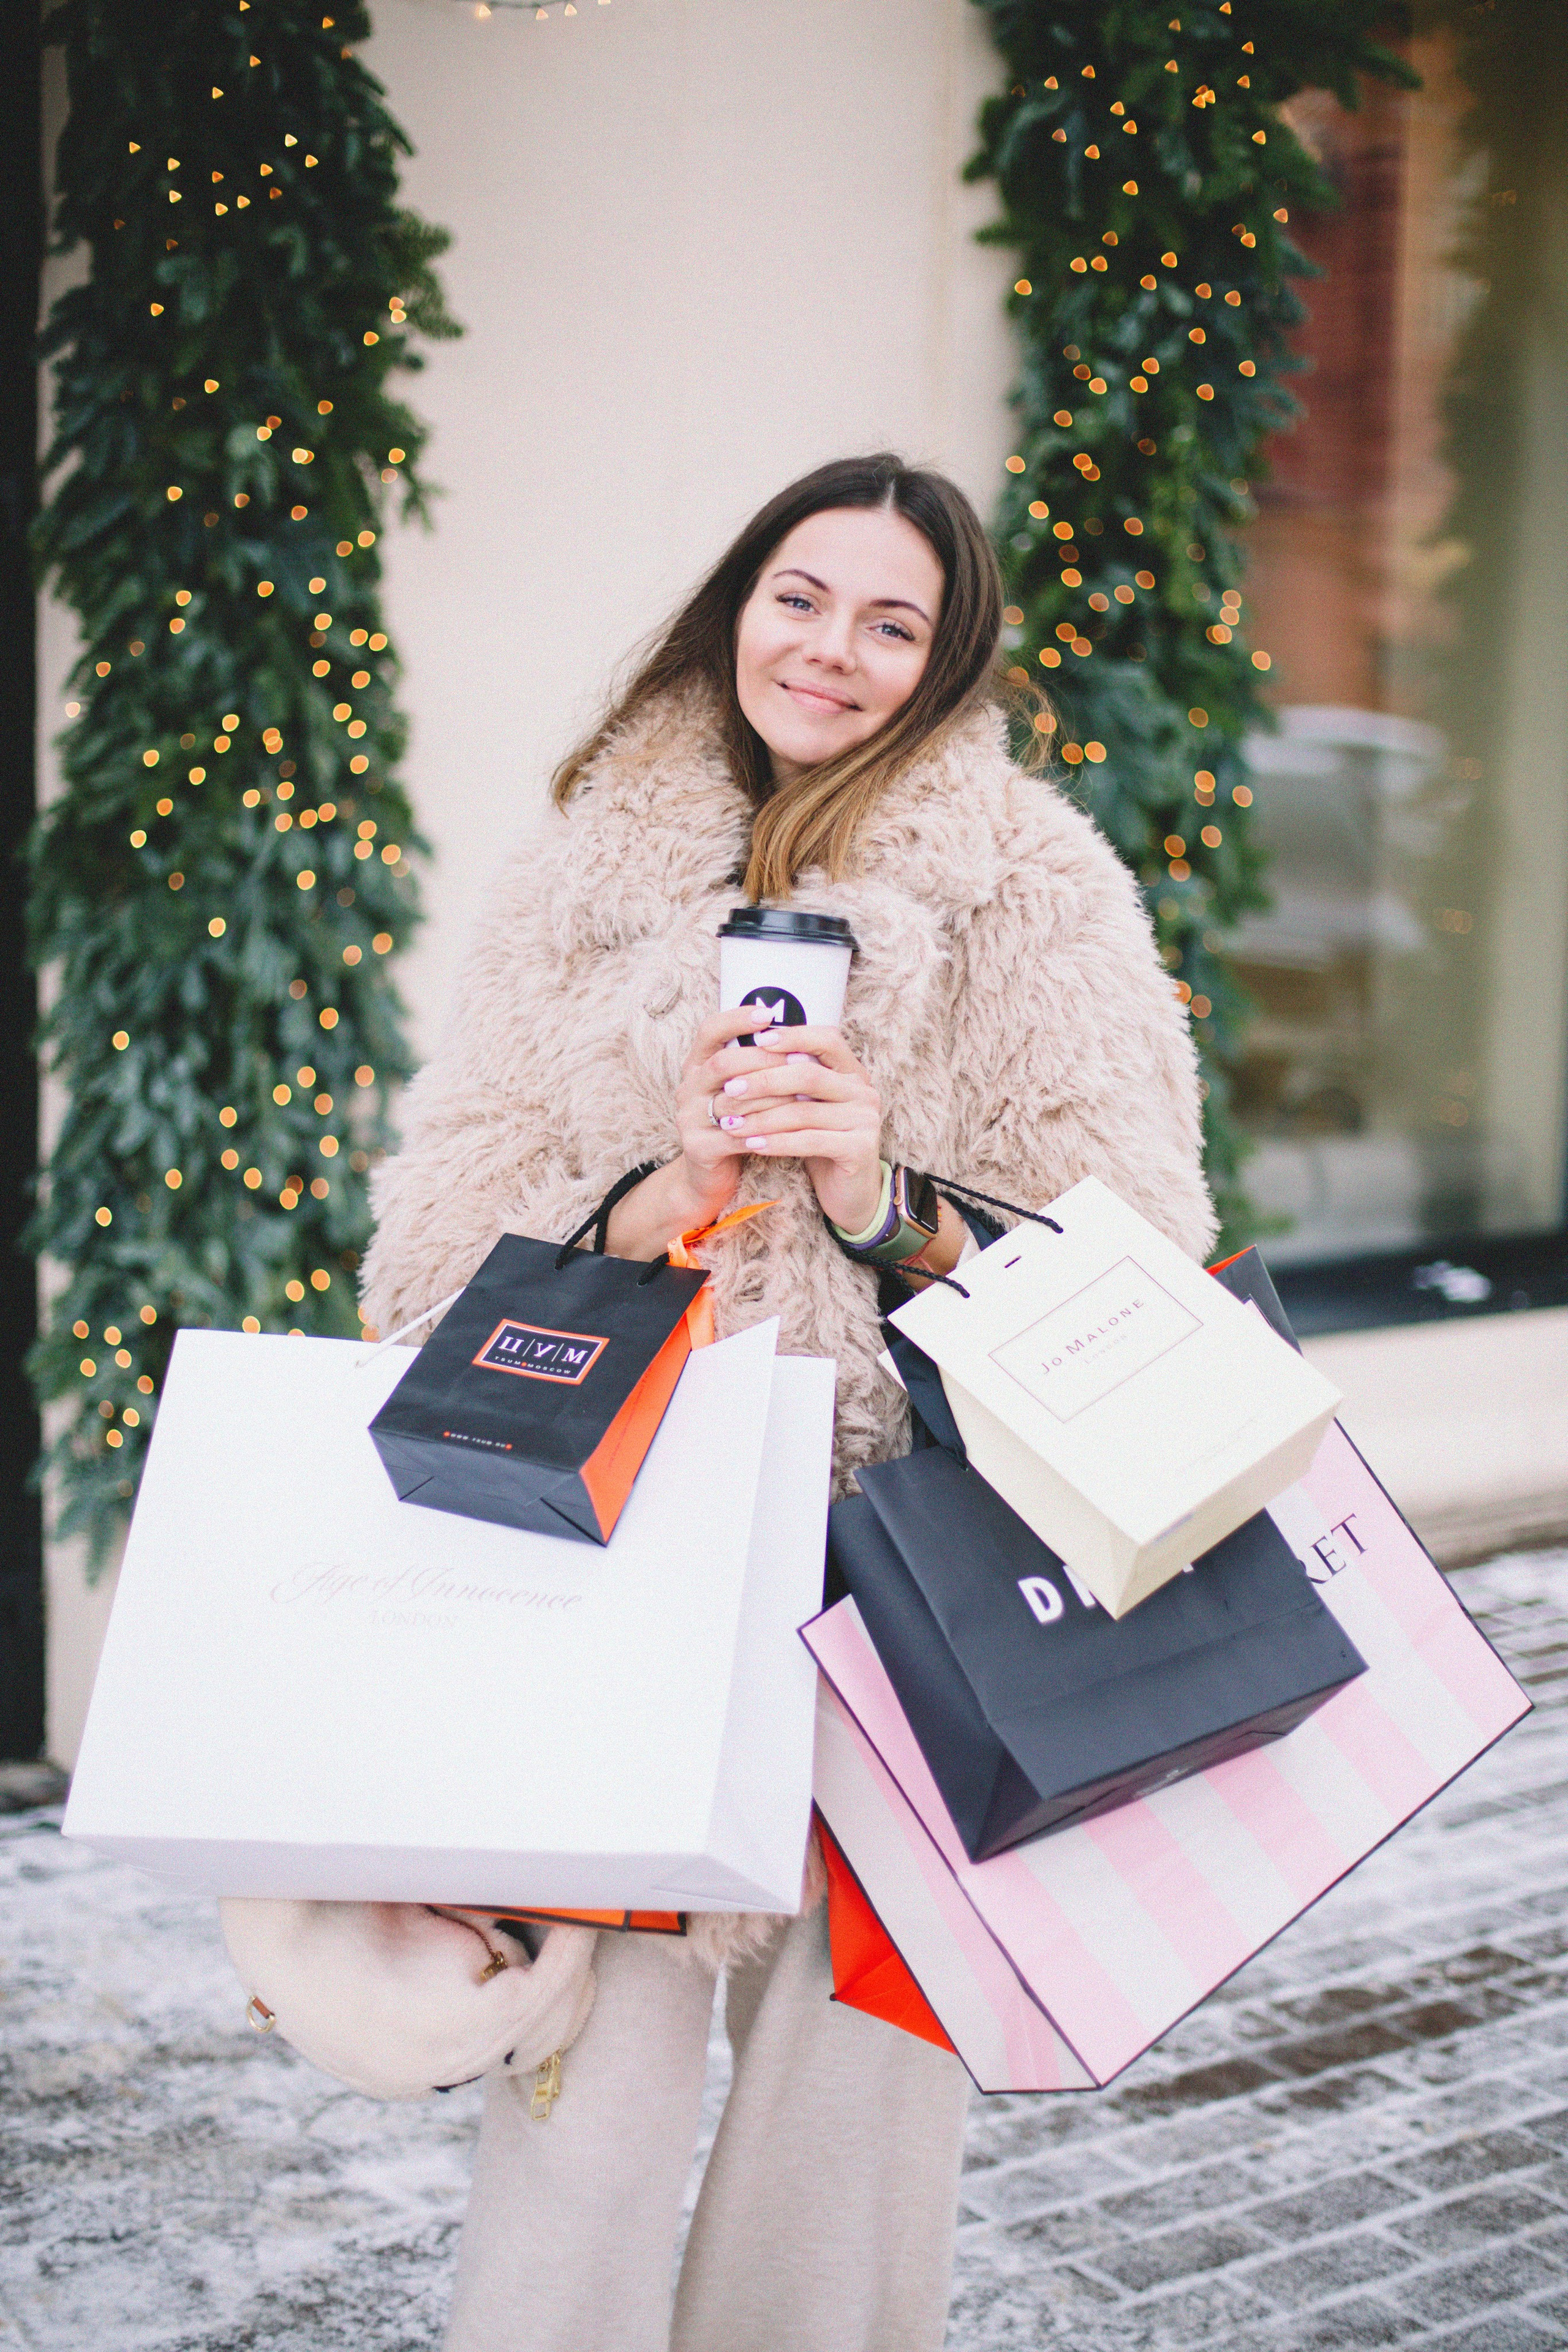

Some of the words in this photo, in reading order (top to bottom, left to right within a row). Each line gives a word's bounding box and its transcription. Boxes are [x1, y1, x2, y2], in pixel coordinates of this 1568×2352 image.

[1065, 1298, 1145, 1355] MALONE
[270, 1562, 368, 1604] Age
[371, 1563, 416, 1600] of
[401, 1567, 583, 1610] Innocence
[371, 1609, 459, 1628] LONDON
